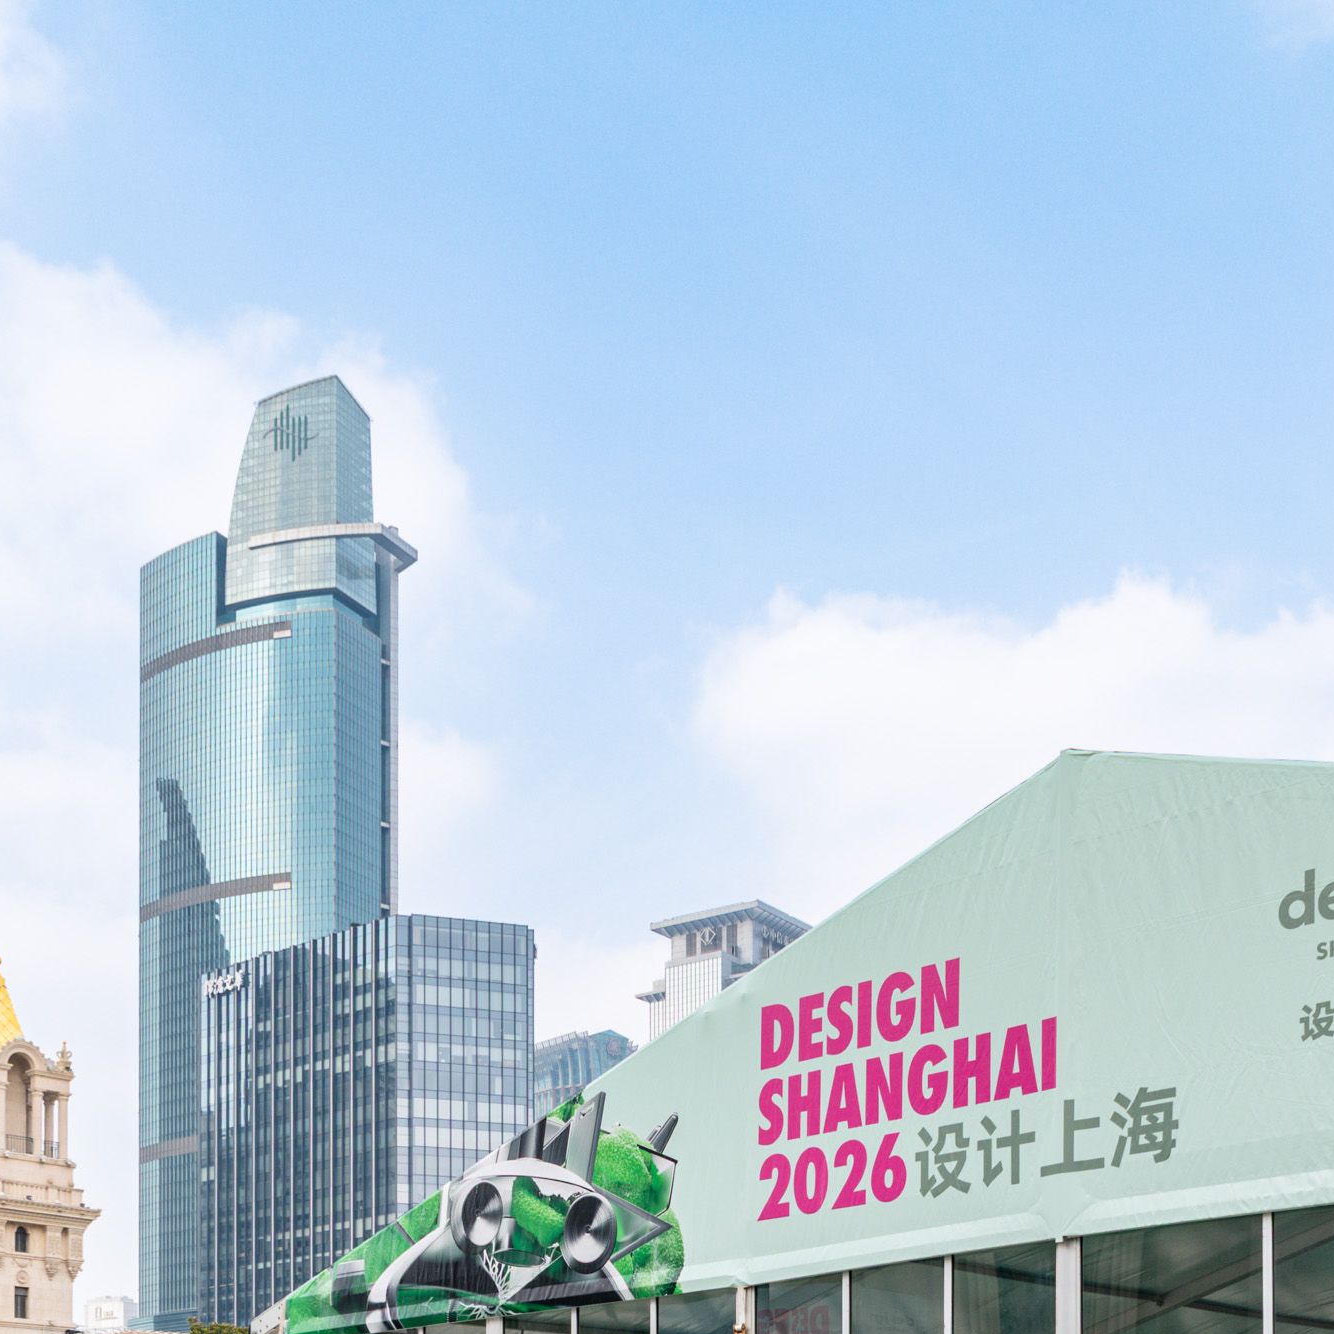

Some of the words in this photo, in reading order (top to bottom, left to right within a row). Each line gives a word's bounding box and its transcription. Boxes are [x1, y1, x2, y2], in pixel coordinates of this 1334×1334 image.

[760, 957, 961, 1070] DESIGN
[758, 1016, 1058, 1146] SHANGHAI
[757, 1132, 907, 1221] 2026
[914, 1087, 1180, 1199] 设计上海
